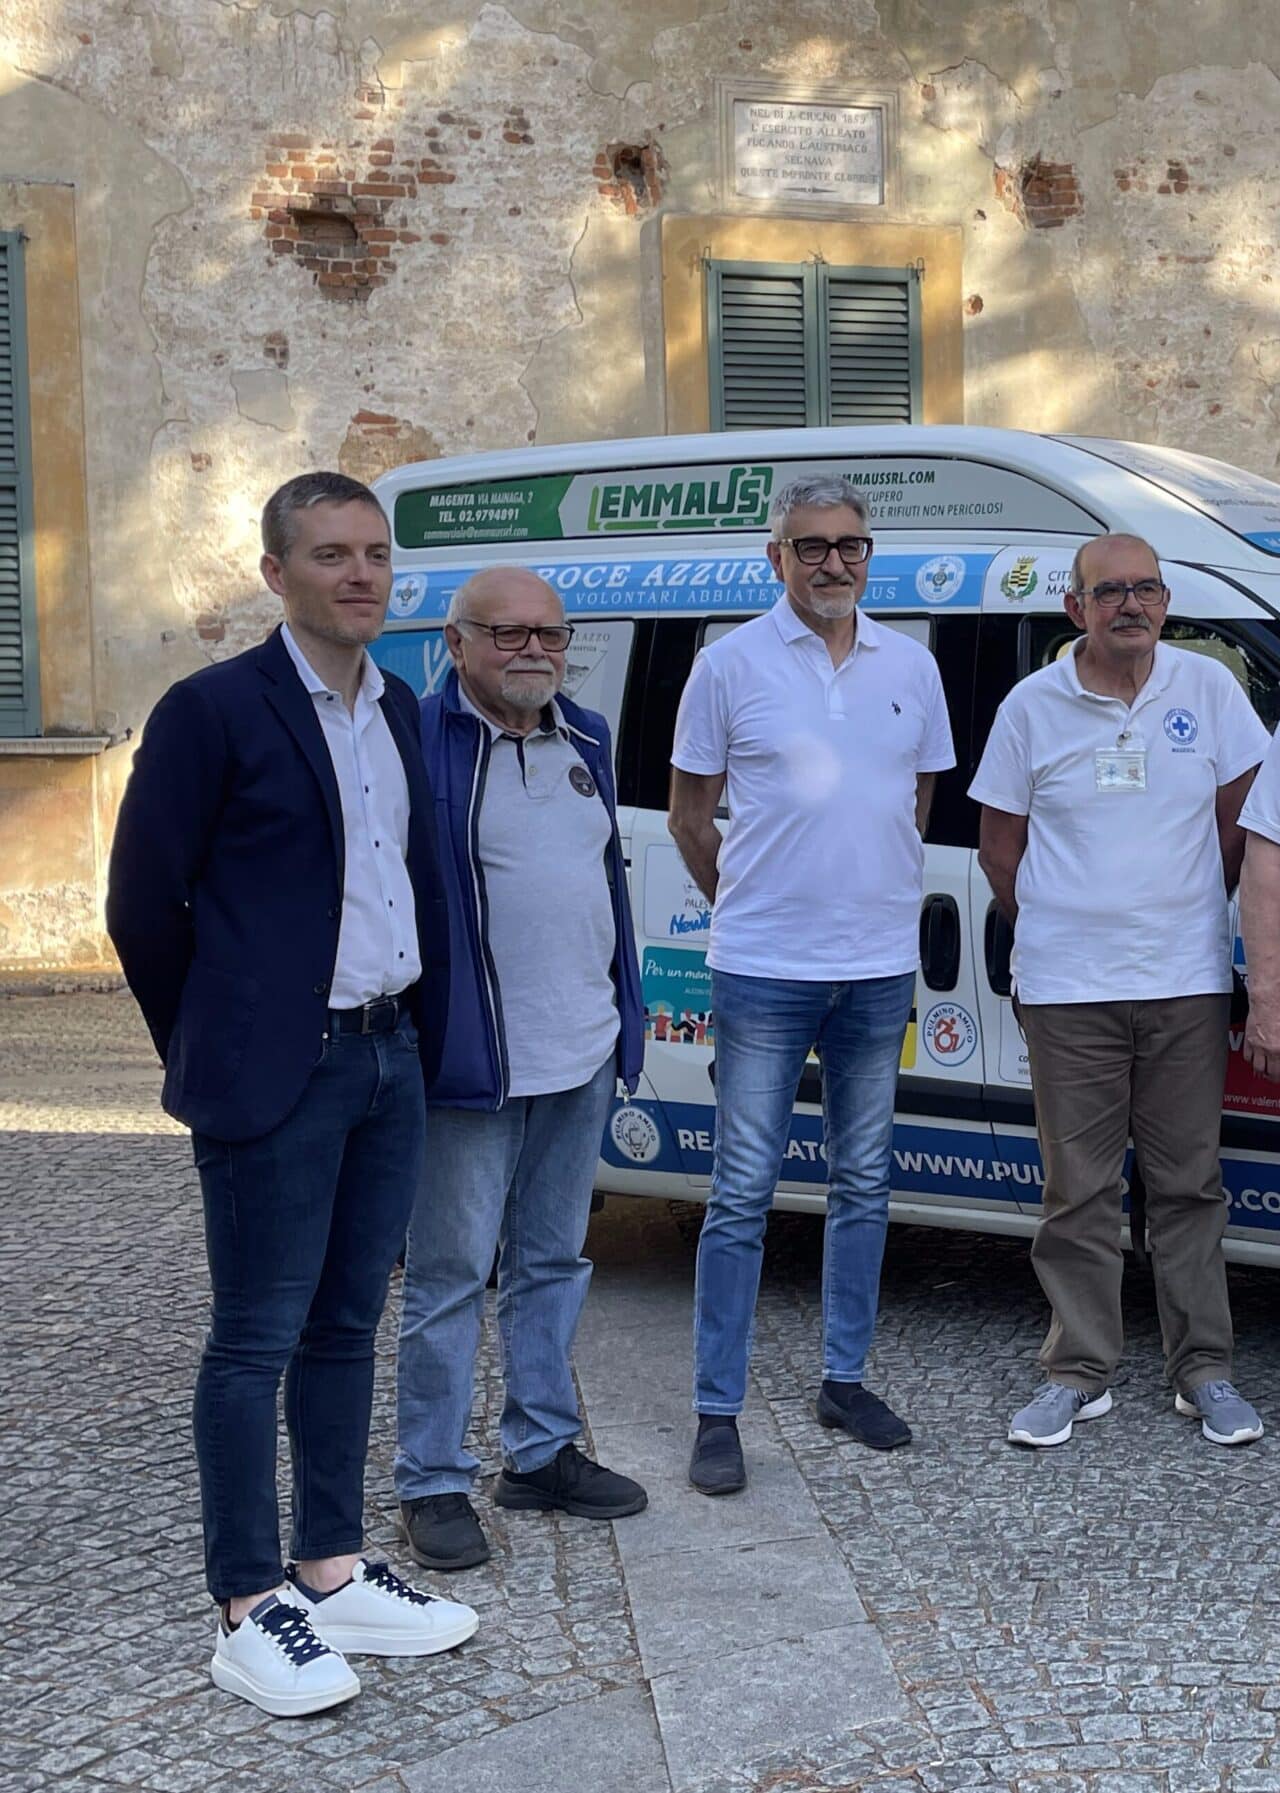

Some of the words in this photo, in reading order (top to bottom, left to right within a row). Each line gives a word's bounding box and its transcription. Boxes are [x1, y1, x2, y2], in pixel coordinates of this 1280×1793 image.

[817, 127, 866, 139] ALLEATO
[784, 155, 833, 167] SEGNAVA
[843, 470, 936, 486] MAUSSRL.COM
[429, 493, 475, 507] MAGENTA
[477, 492, 489, 504] VIA
[600, 467, 761, 518] EMMAUS
[865, 490, 904, 503] CUPERO
[439, 510, 456, 523] TEL.
[887, 504, 920, 518] RIFIUTI
[923, 504, 945, 517] NON
[948, 502, 1003, 516] PERICOLOSI
[536, 565, 631, 589] ROCE
[642, 561, 780, 587] AZZUR
[1048, 570, 1072, 581] CITT
[576, 590, 679, 606] VOLONTARI
[688, 588, 784, 603] ABBIATEN
[645, 959, 664, 977] Per
[667, 968, 682, 978] un
[927, 1007, 955, 1037] PULMINO
[957, 1011, 974, 1044] AMICO
